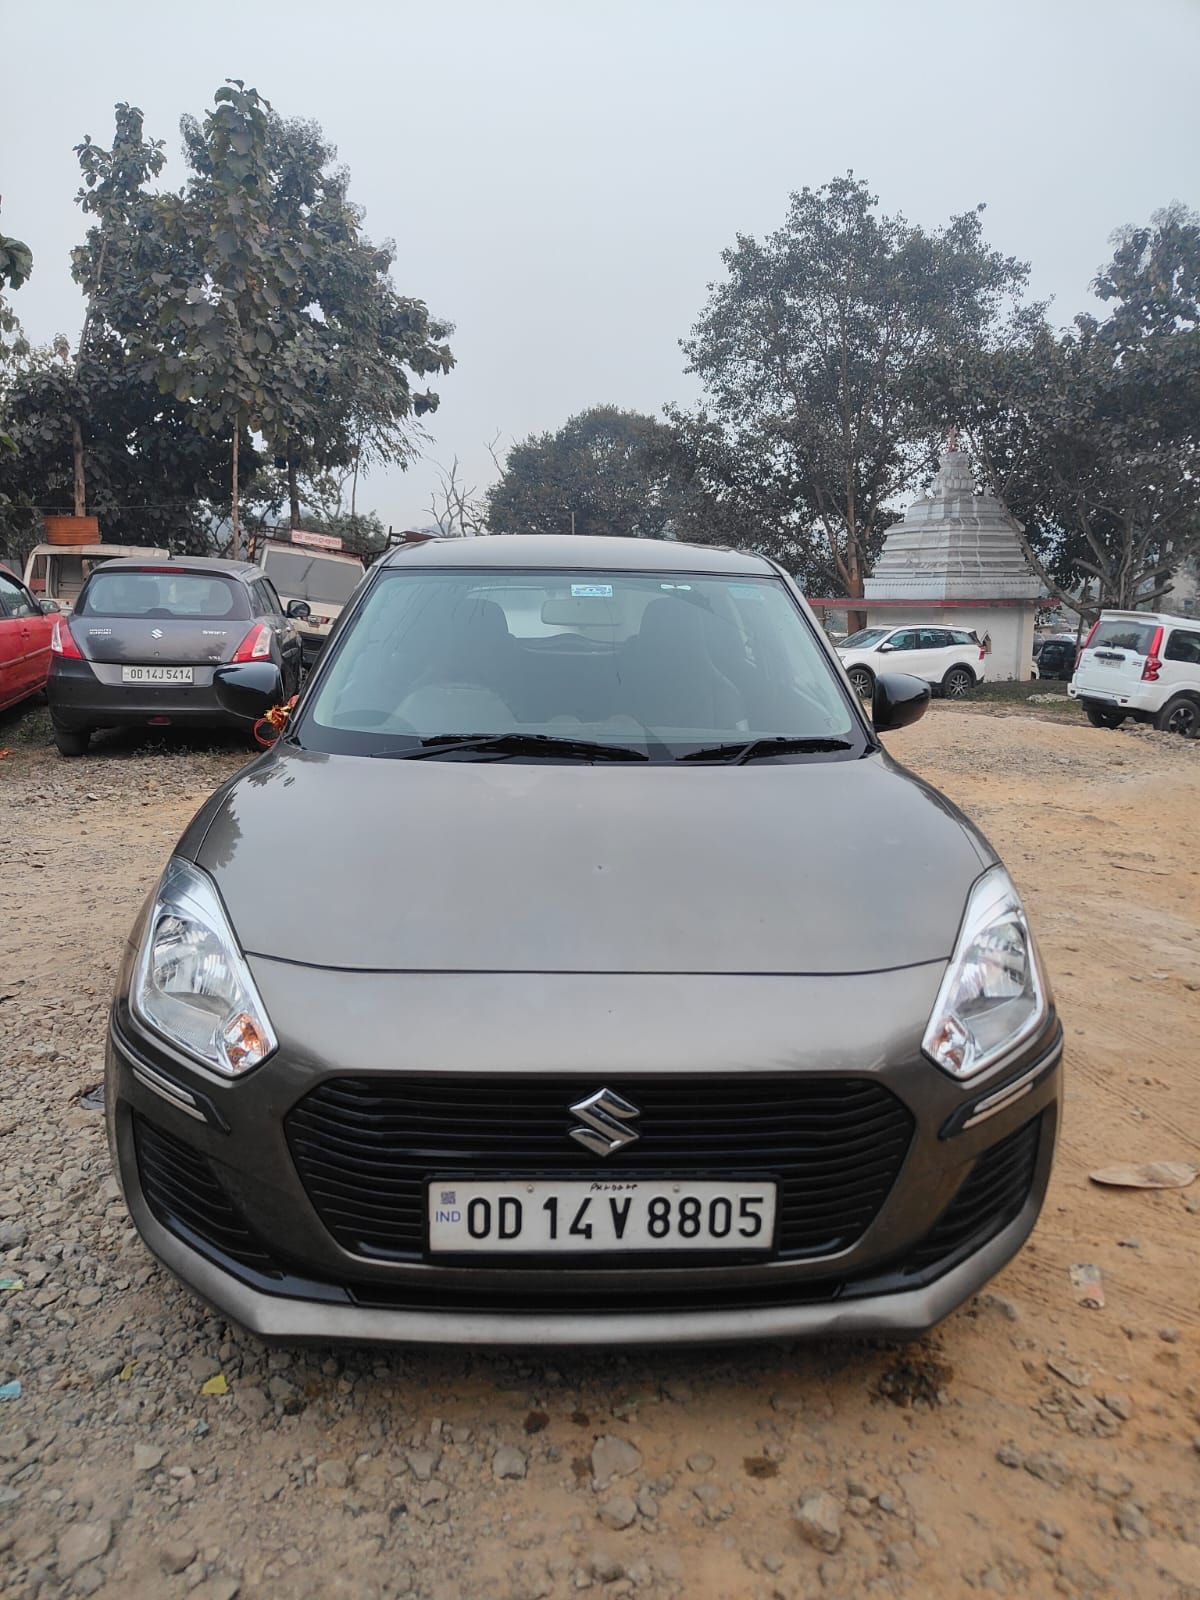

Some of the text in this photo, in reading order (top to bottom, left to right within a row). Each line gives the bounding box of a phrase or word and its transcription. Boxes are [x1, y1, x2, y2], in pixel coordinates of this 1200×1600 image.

[130, 669, 143, 679] OD
[166, 669, 191, 680] 5414
[435, 1210, 461, 1222] IND
[467, 1197, 522, 1239] OD
[647, 1196, 764, 1239] 8805
